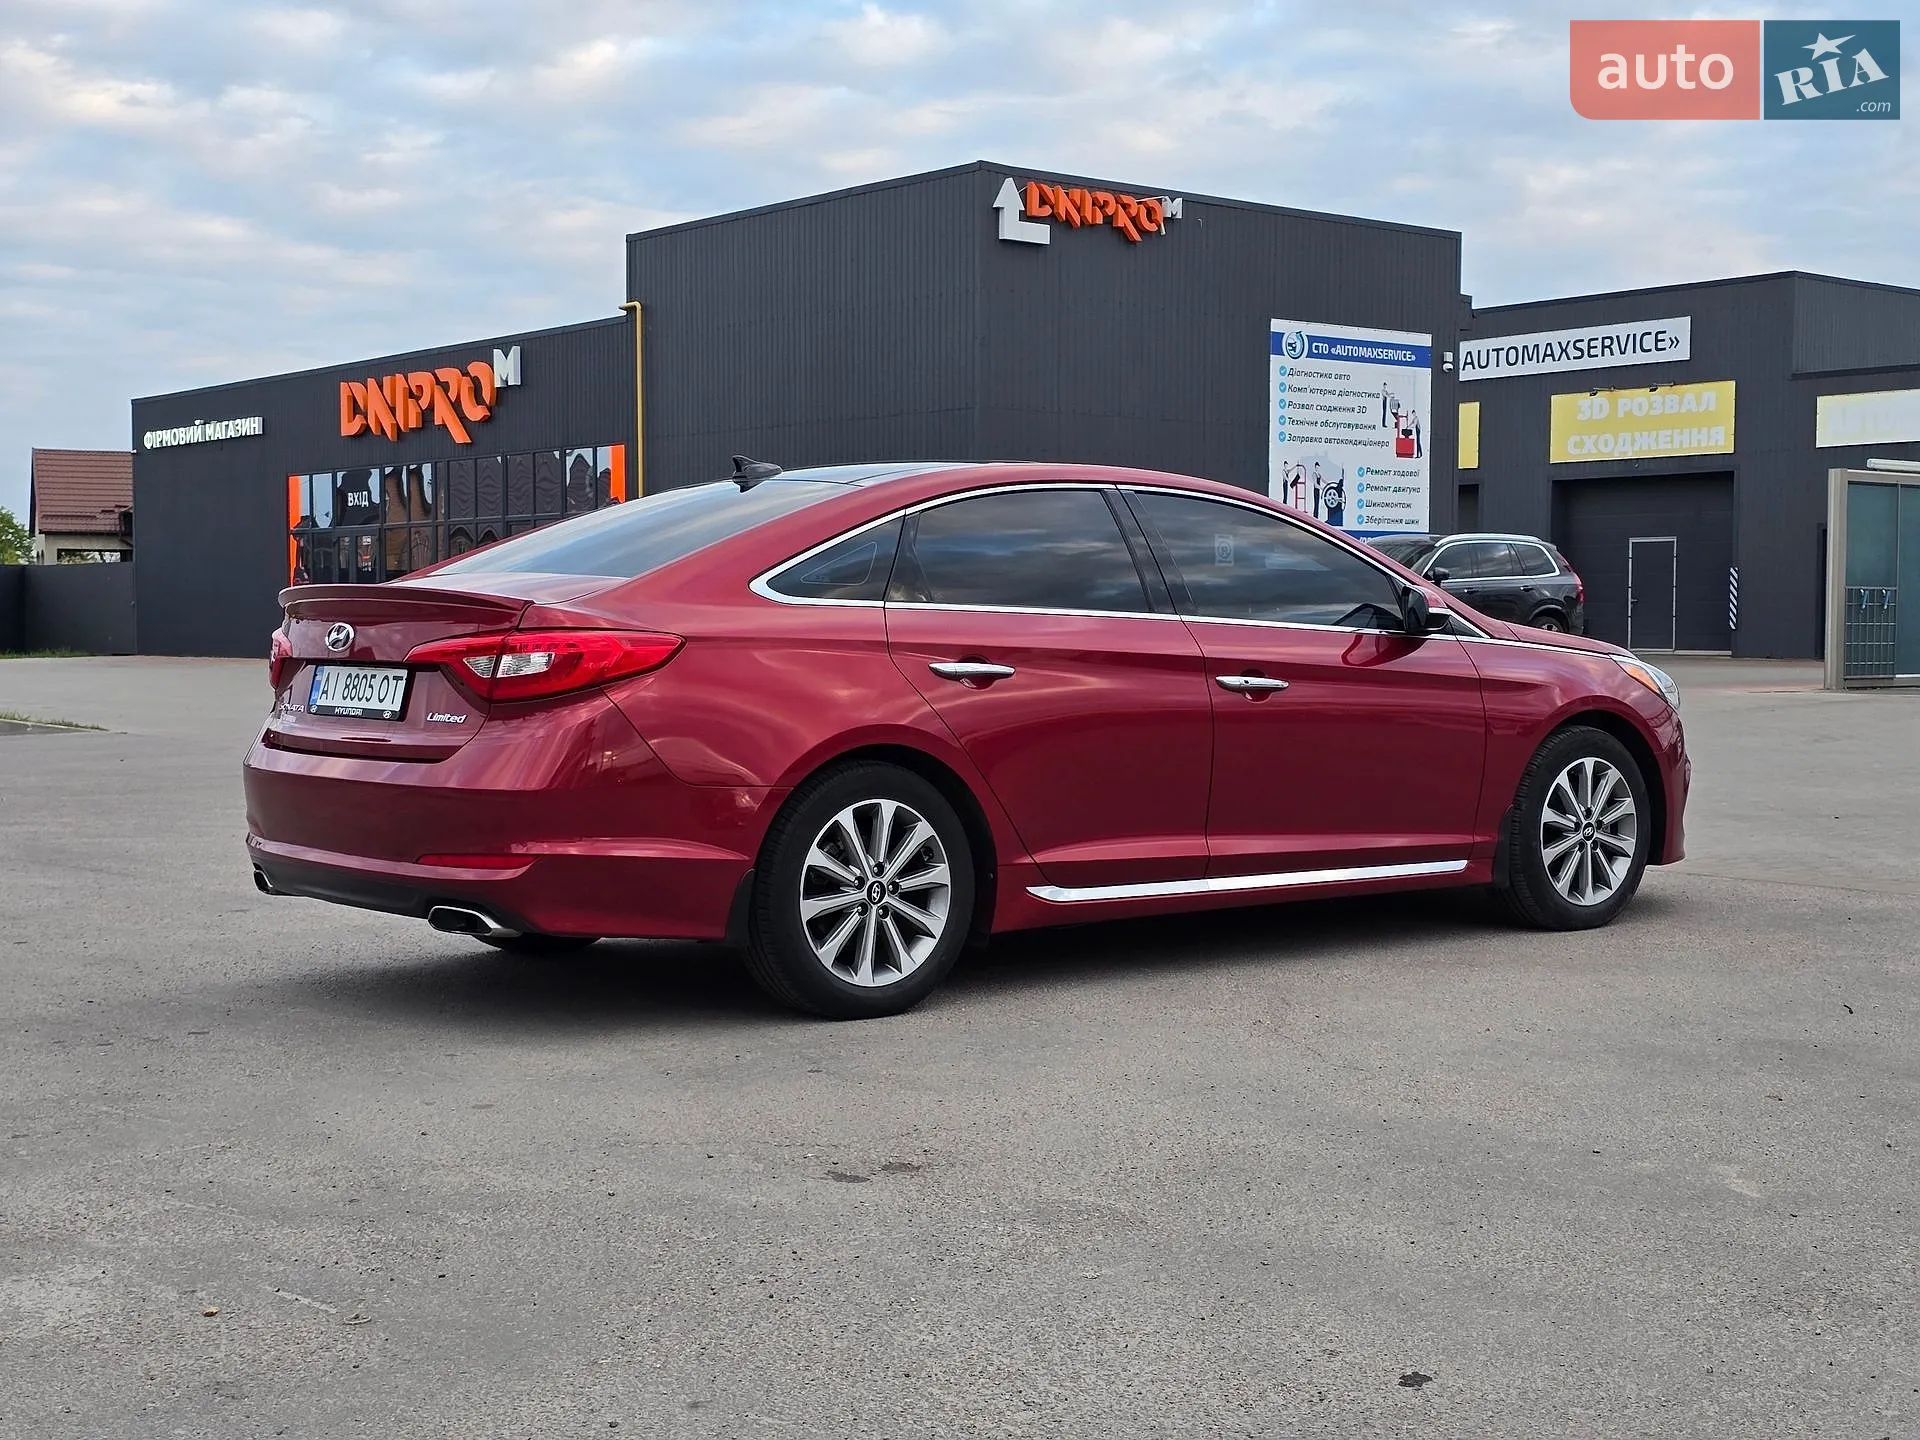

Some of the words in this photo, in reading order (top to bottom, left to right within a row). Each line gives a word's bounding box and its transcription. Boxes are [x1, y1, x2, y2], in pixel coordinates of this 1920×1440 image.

[1312, 342, 1329, 354] СТО
[1288, 367, 1333, 380] Діагностика
[1334, 373, 1351, 381] авто
[1337, 388, 1380, 399] діагностика
[1287, 400, 1314, 411] Розвал
[1315, 404, 1356, 414] сходження
[1617, 391, 1717, 418] РОЗВАЛ
[1287, 416, 1319, 427] Технічне
[1319, 419, 1377, 431] обслуговування
[143, 419, 205, 450] ФІРМОВИЙ
[205, 416, 263, 442] МАГАЗИН
[1287, 433, 1323, 444] Заправка
[1567, 426, 1726, 457] СХОДЖЕННЯ
[1365, 466, 1392, 476] Ремонт
[1392, 469, 1420, 478] ходової
[1365, 483, 1392, 493] Ремонт
[1392, 486, 1421, 496] двигуна
[347, 491, 369, 508] ВХІД
[1365, 499, 1413, 510] Шиномонтаж
[1364, 515, 1404, 526] Зберігання
[341, 672, 377, 703] 8805
[377, 674, 404, 705] OT
[334, 706, 364, 717] HYUNDAI
[426, 712, 467, 724] Limited
